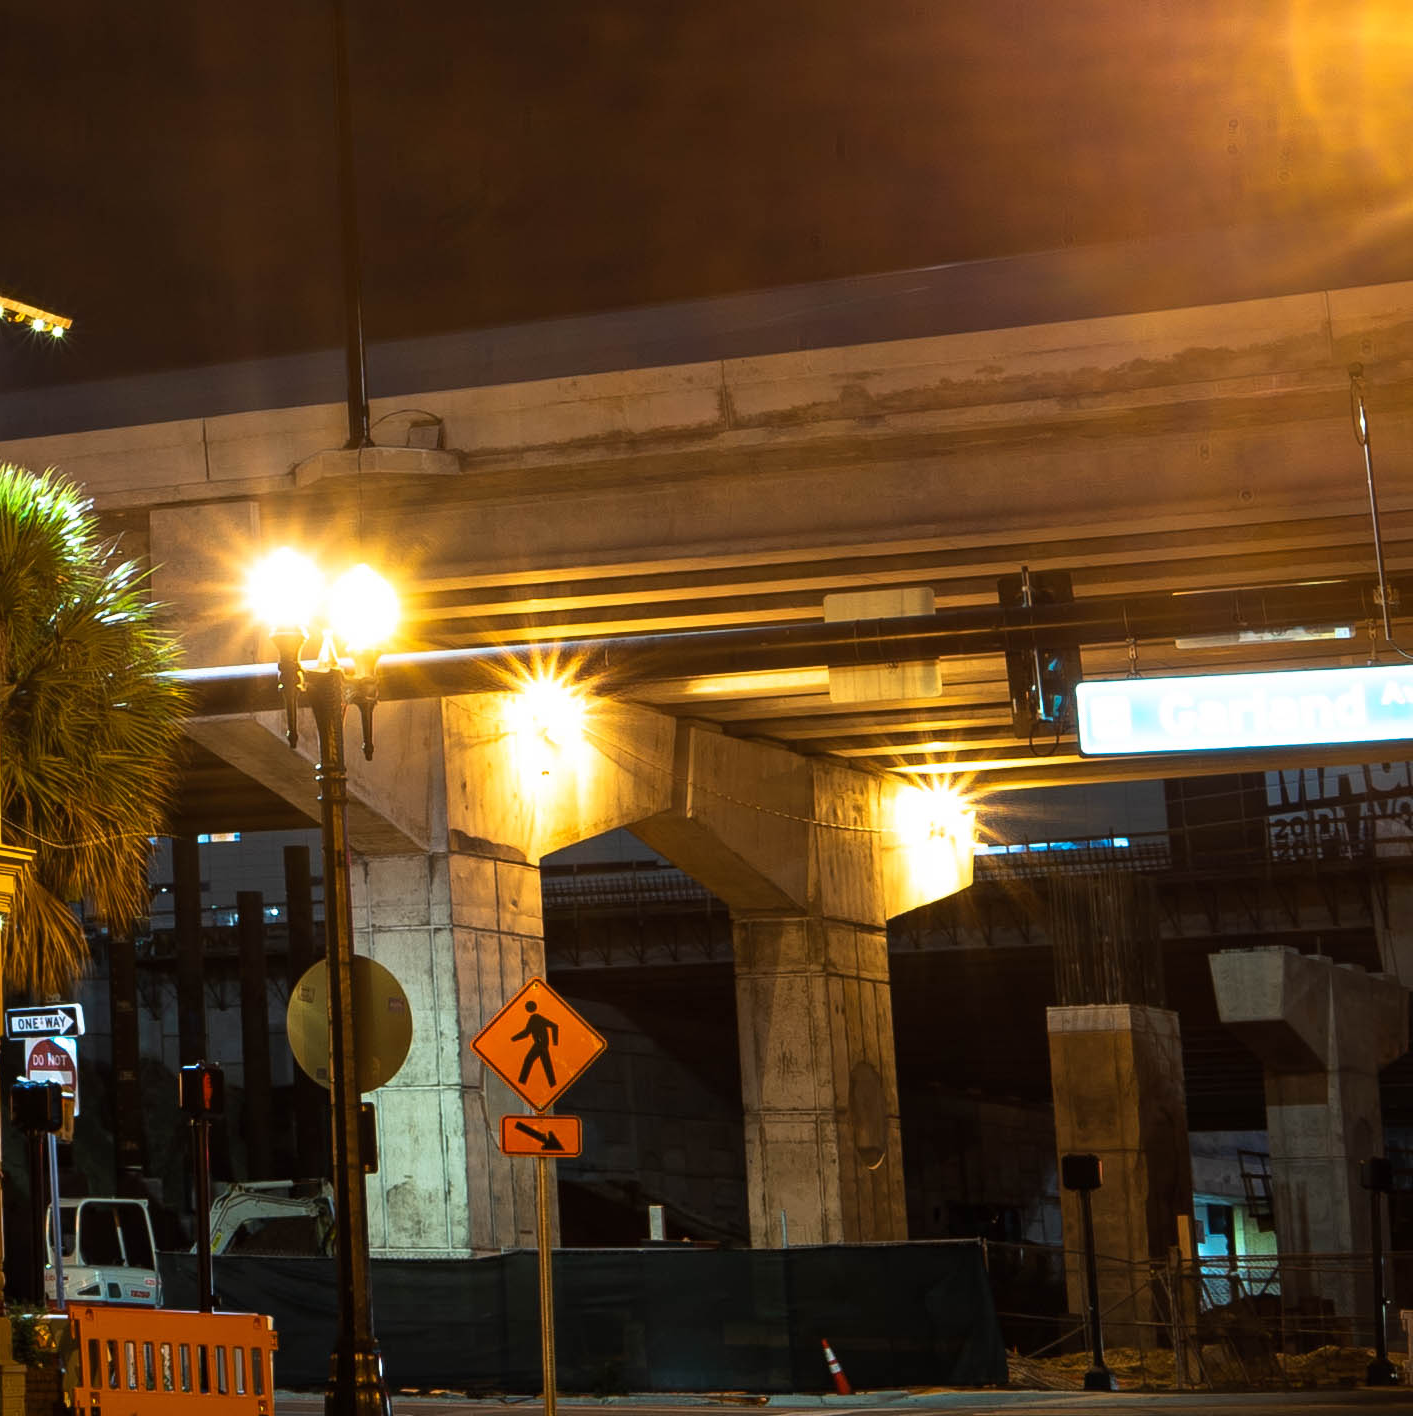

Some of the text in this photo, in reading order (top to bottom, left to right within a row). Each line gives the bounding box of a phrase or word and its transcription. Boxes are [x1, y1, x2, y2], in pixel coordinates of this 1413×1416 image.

[1159, 680, 1365, 737] Garland
[17, 1016, 66, 1031] ONE WAY
[33, 1053, 67, 1066] DO NOT
